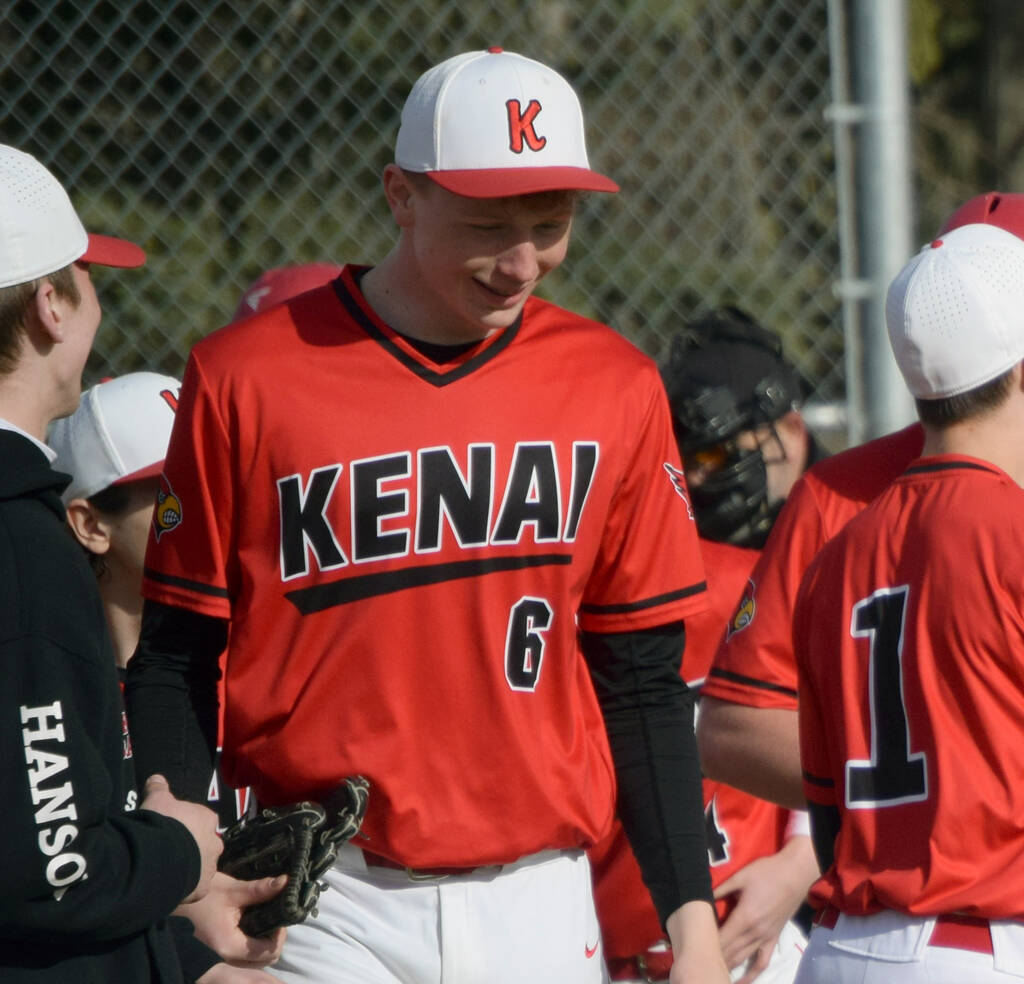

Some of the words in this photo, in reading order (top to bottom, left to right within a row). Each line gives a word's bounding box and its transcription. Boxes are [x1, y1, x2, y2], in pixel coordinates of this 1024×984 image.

[505, 98, 547, 154] K
[276, 440, 600, 582] KENAI
[504, 595, 554, 692] 6
[845, 584, 929, 810] 1
[20, 700, 89, 902] HANSO
